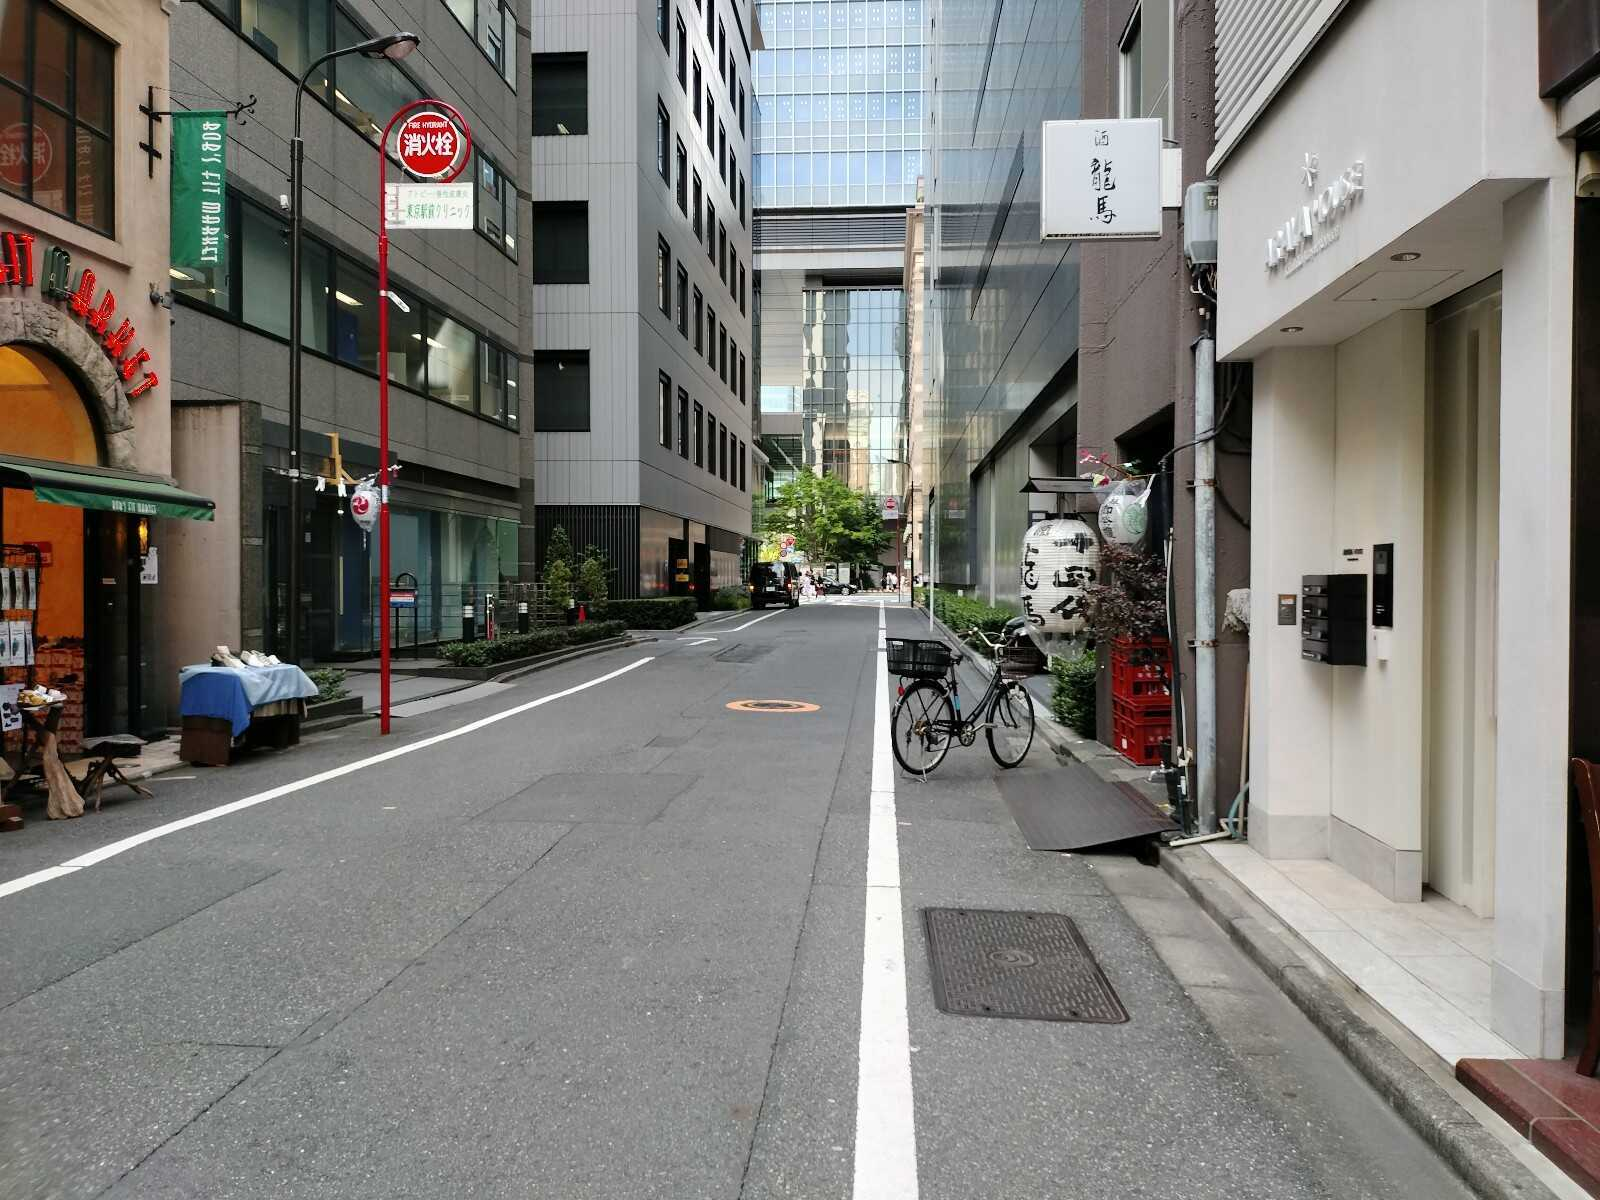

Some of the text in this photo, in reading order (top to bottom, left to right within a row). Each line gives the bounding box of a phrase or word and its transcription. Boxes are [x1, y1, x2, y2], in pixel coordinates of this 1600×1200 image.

[408, 121, 448, 129] FIRE HYDRANT
[404, 132, 454, 157] 消火栓
[201, 121, 222, 264] BOB'S FIT MARKET
[1089, 157, 1118, 226] 龍馬
[406, 203, 471, 220] 東京駅前クリニック
